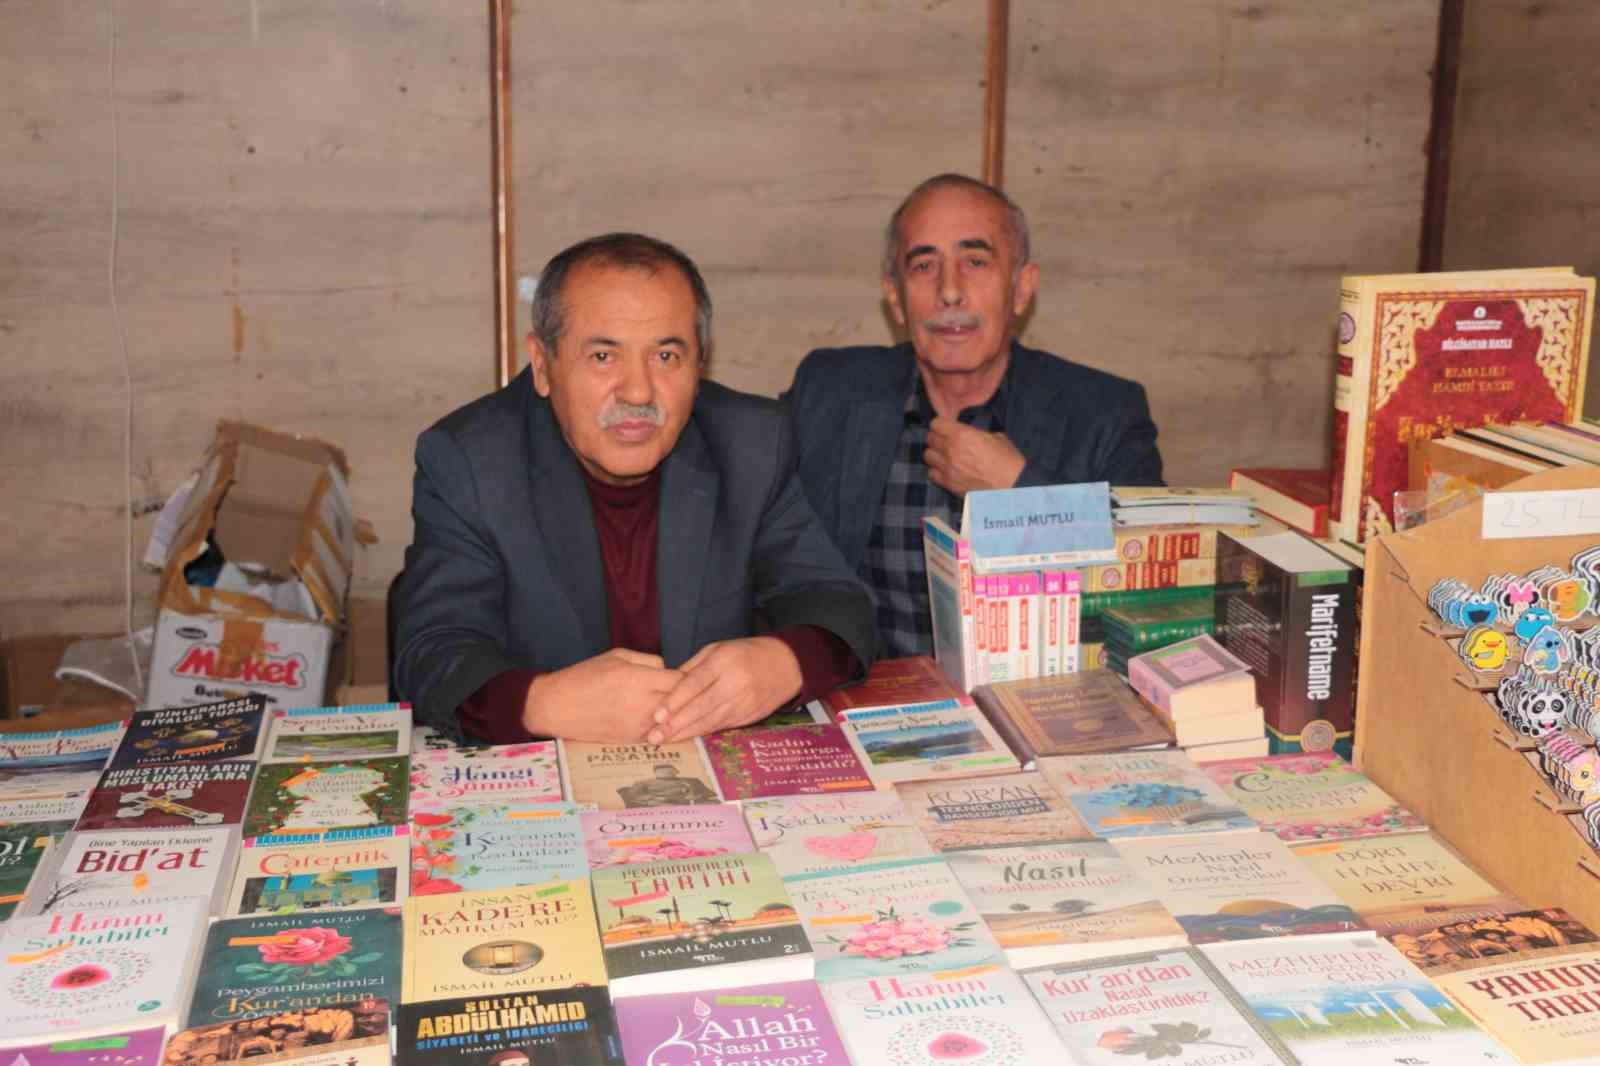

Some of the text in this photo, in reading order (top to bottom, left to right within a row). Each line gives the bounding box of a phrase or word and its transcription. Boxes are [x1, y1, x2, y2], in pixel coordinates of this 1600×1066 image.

[1027, 511, 1075, 526] MUTLU
[1500, 495, 1541, 528] 25
[1306, 593, 1341, 701] Marifetname
[76, 847, 209, 874] Bid'at
[422, 897, 578, 927] KADERE
[708, 935, 774, 951] MUTLU
[465, 995, 539, 1013] SULTAN
[417, 1001, 587, 1040] ABDÜLHAMİD
[699, 1012, 817, 1042] Allah
[696, 1035, 821, 1057] Nasıl Bir
